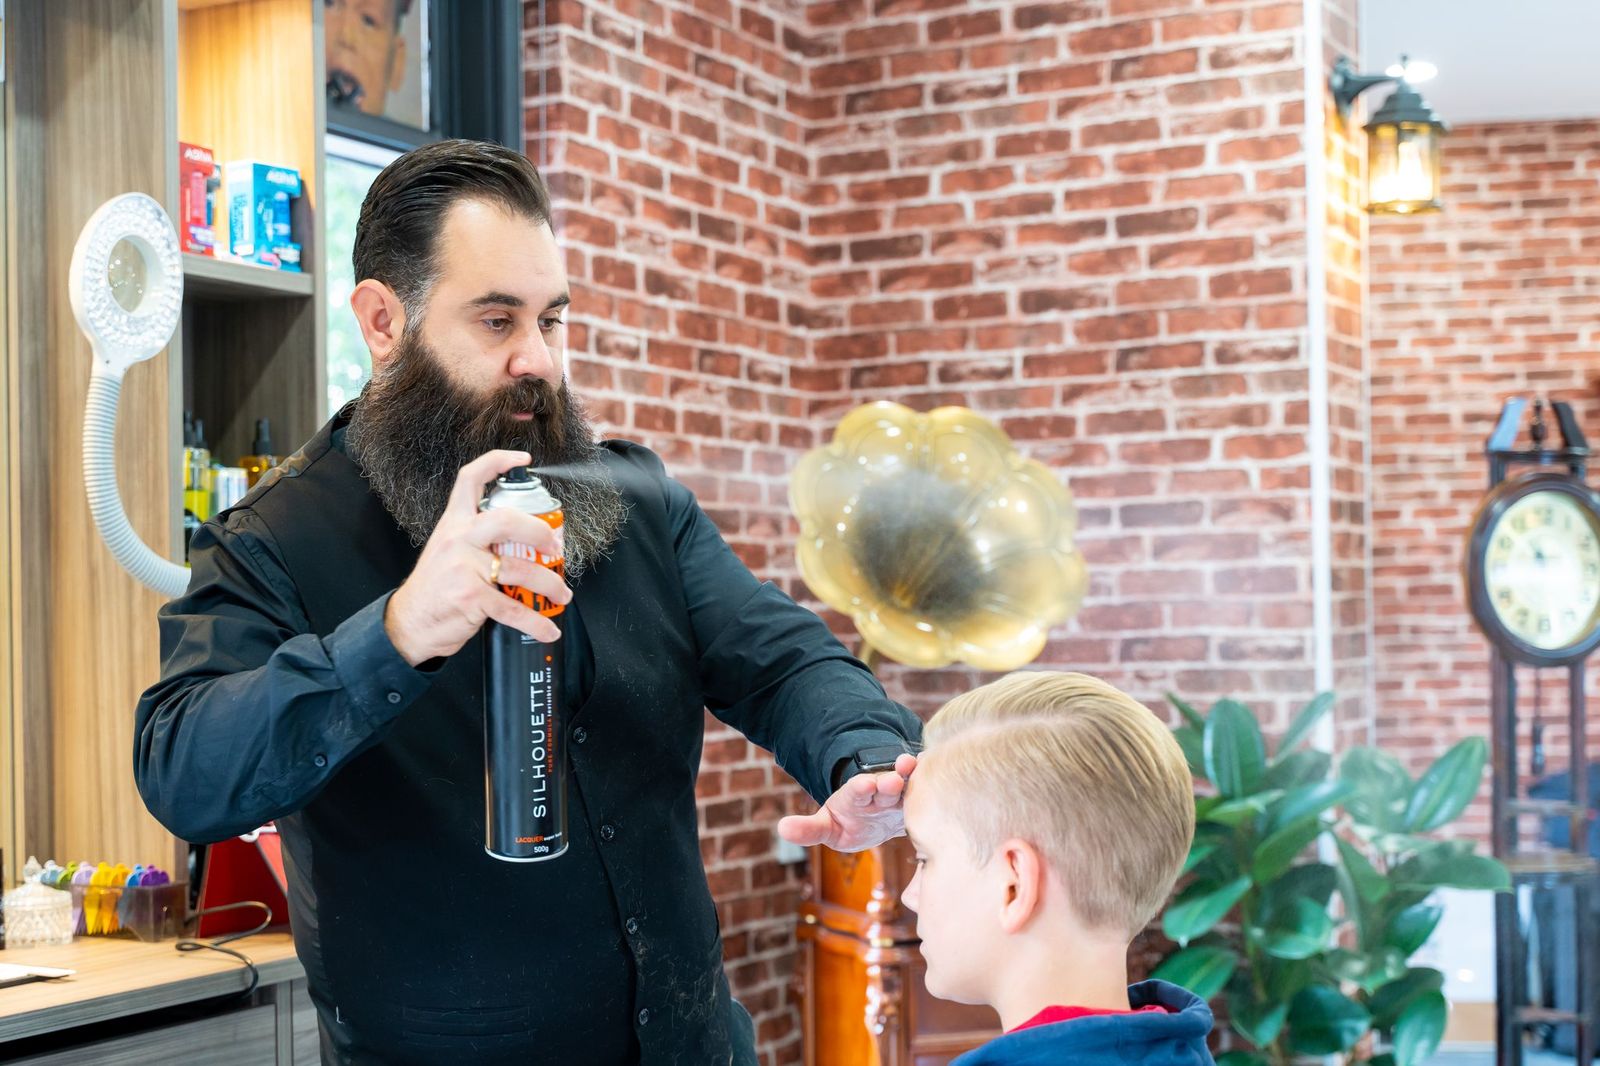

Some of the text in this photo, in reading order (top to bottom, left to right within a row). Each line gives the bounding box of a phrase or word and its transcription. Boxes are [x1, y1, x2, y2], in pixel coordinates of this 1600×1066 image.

[529, 670, 547, 818] SILHOUETTE
[515, 835, 544, 844] LACQUER
[533, 845, 549, 853] 500g
